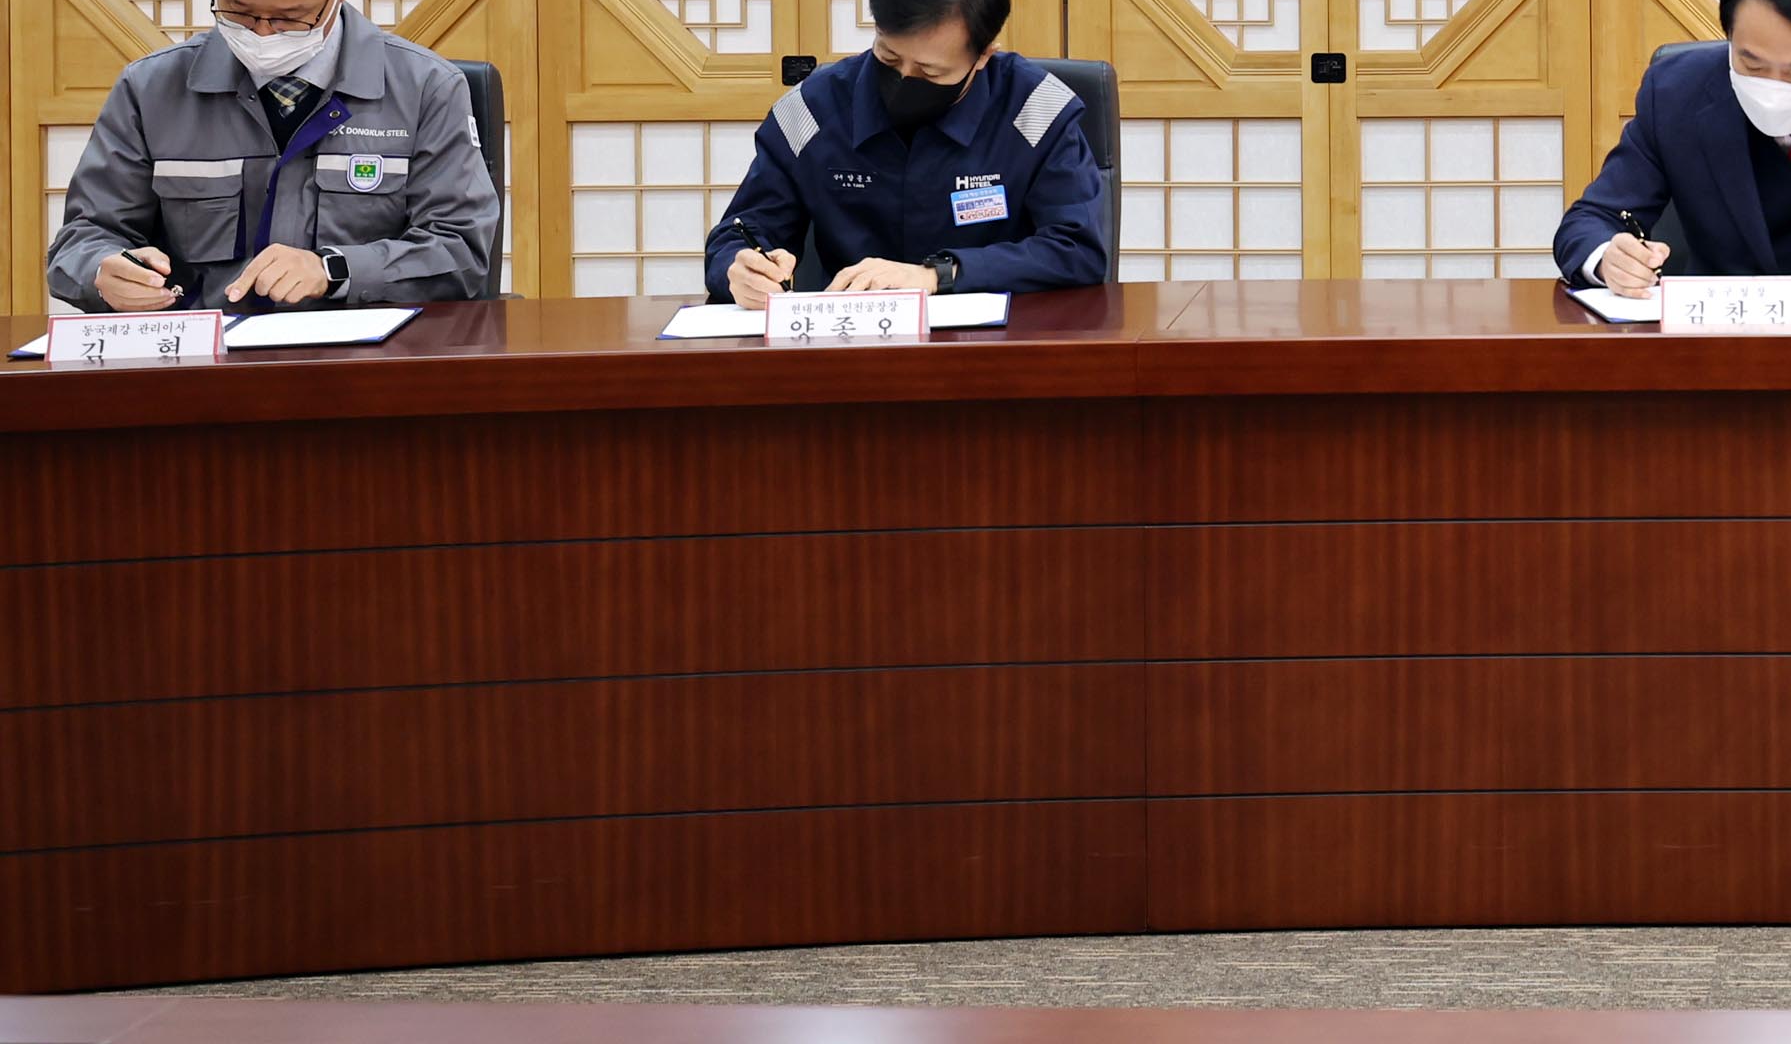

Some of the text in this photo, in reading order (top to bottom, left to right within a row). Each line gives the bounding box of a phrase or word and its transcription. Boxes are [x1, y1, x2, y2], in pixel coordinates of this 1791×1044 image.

[346, 127, 385, 137] DONGKUK
[386, 129, 409, 137] STEEL
[138, 321, 186, 335] 관리이사
